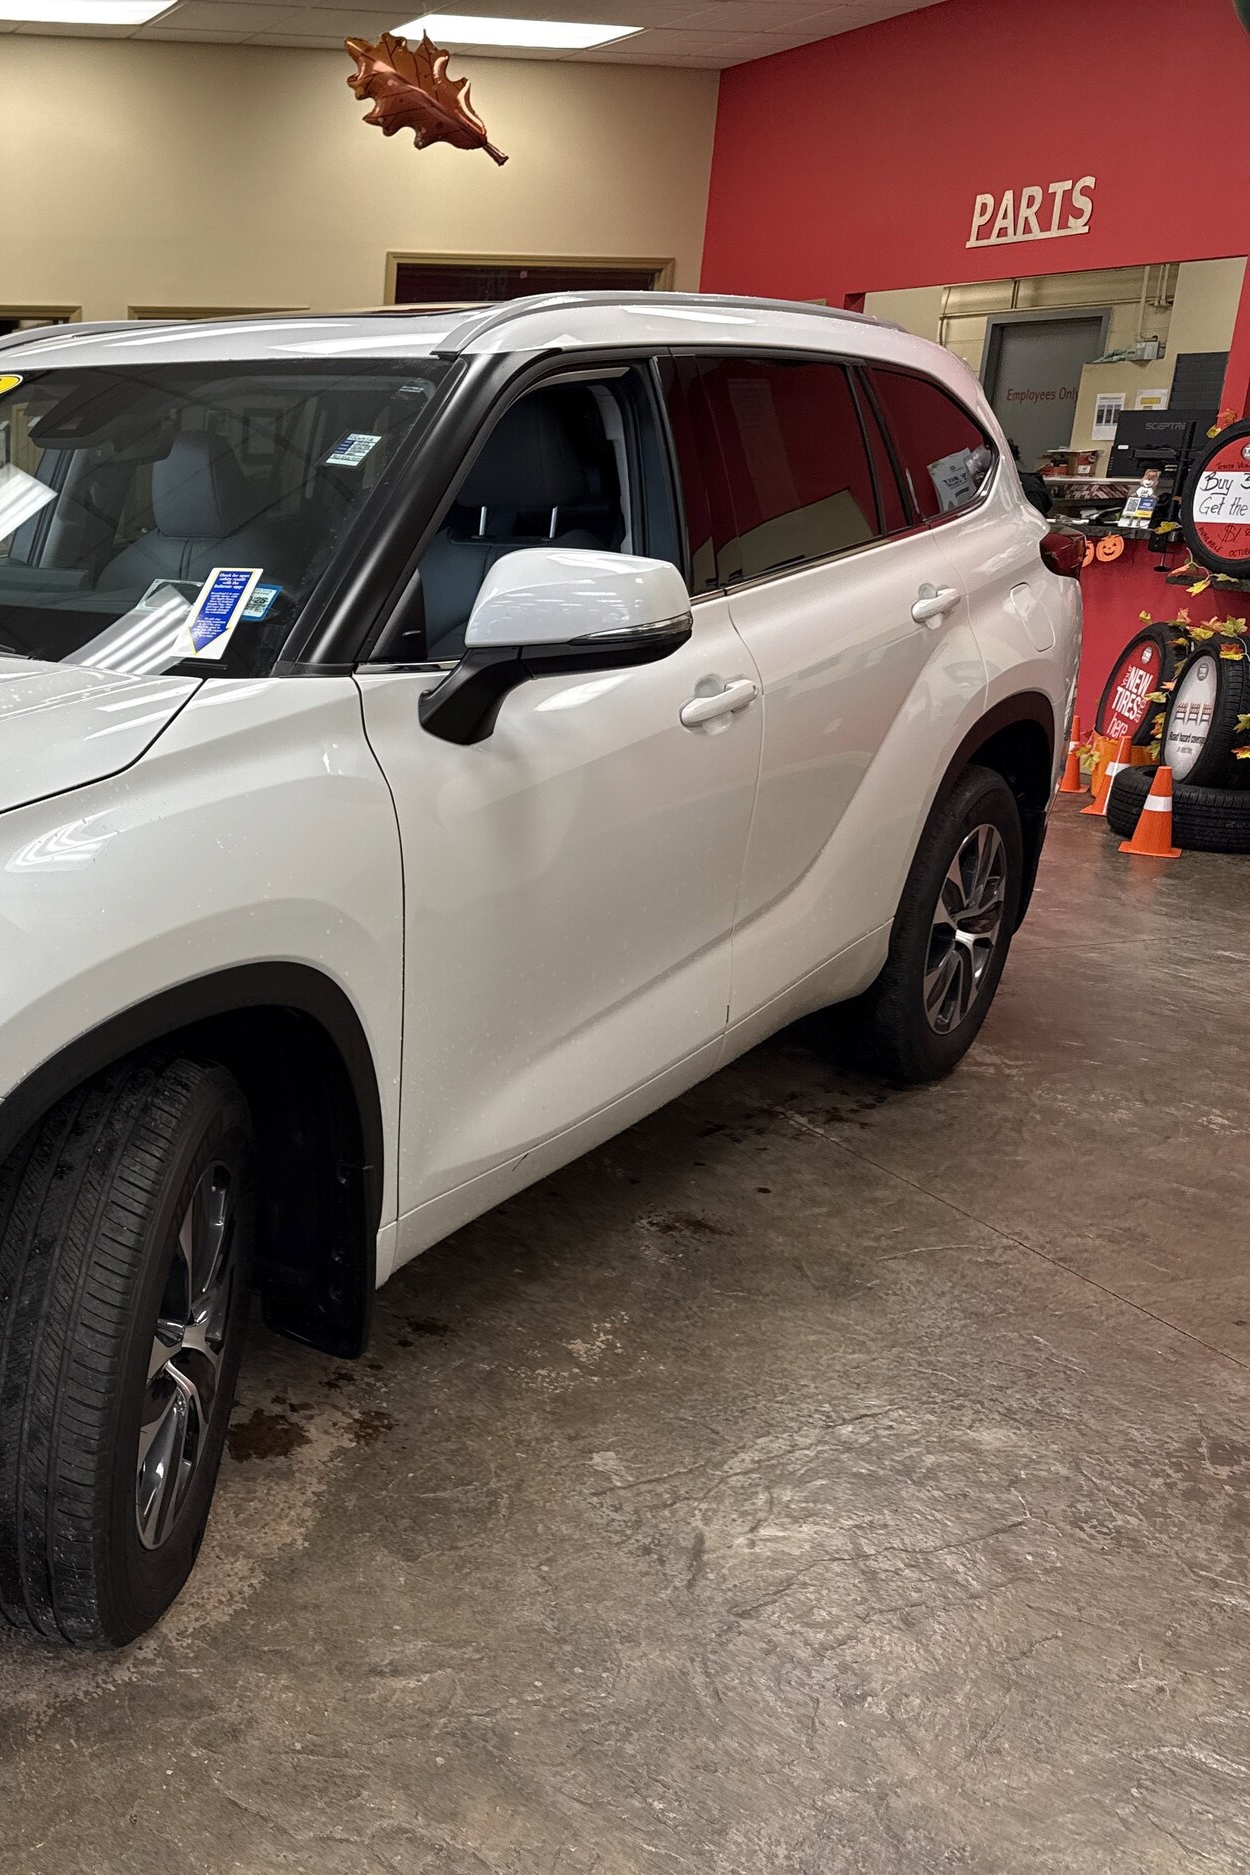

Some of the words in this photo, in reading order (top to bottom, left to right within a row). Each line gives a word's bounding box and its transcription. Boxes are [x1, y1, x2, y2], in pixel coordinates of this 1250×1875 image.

[967, 176, 1096, 243] PARTS
[1006, 388, 1056, 404] Employees
[1199, 471, 1233, 496] Buy
[1198, 496, 1225, 515] Get
[1229, 496, 1248, 516] the
[1198, 526, 1222, 553] AVAILABLE
[1125, 666, 1153, 698] NEW
[1111, 686, 1141, 721] TIRES
